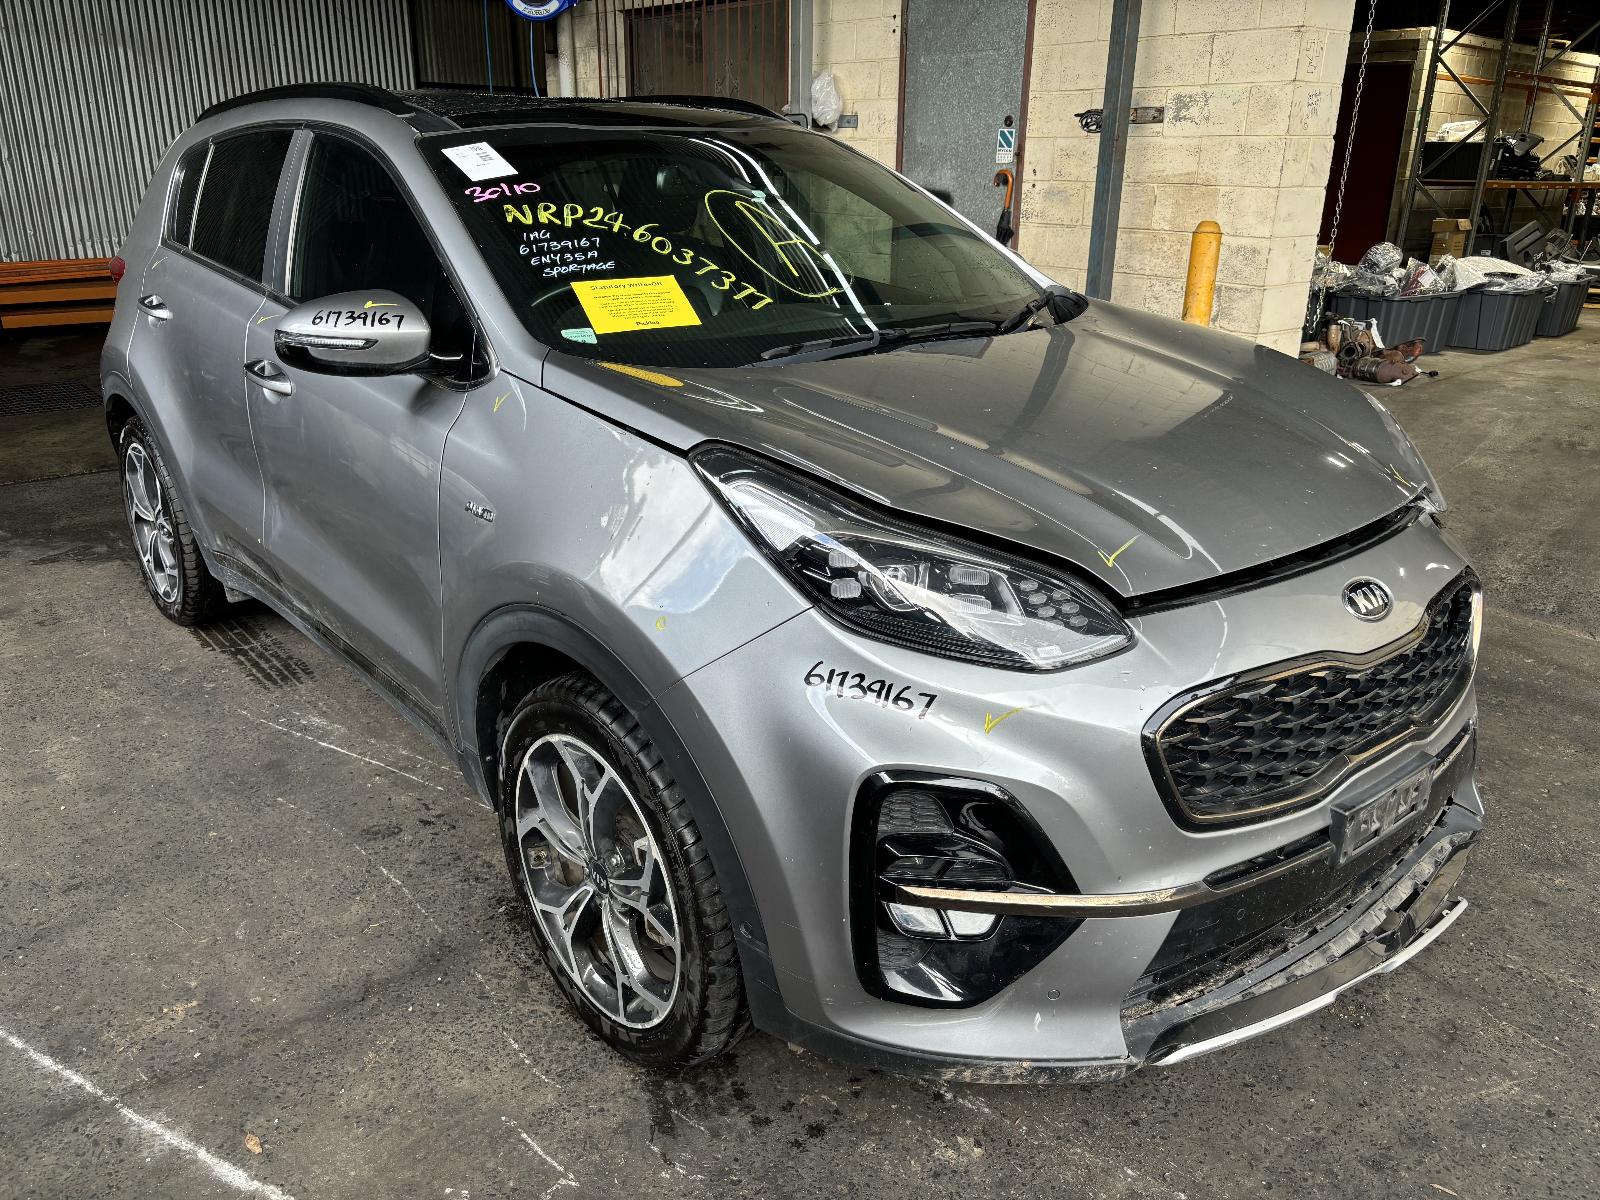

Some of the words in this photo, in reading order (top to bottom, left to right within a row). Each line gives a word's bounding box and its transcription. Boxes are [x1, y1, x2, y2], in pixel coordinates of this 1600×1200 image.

[519, 238, 600, 255] 61739167
[542, 260, 616, 278] SPORTAGE
[311, 309, 405, 331] 61739167
[1349, 584, 1389, 614] KIA
[803, 660, 938, 720] 61739167
